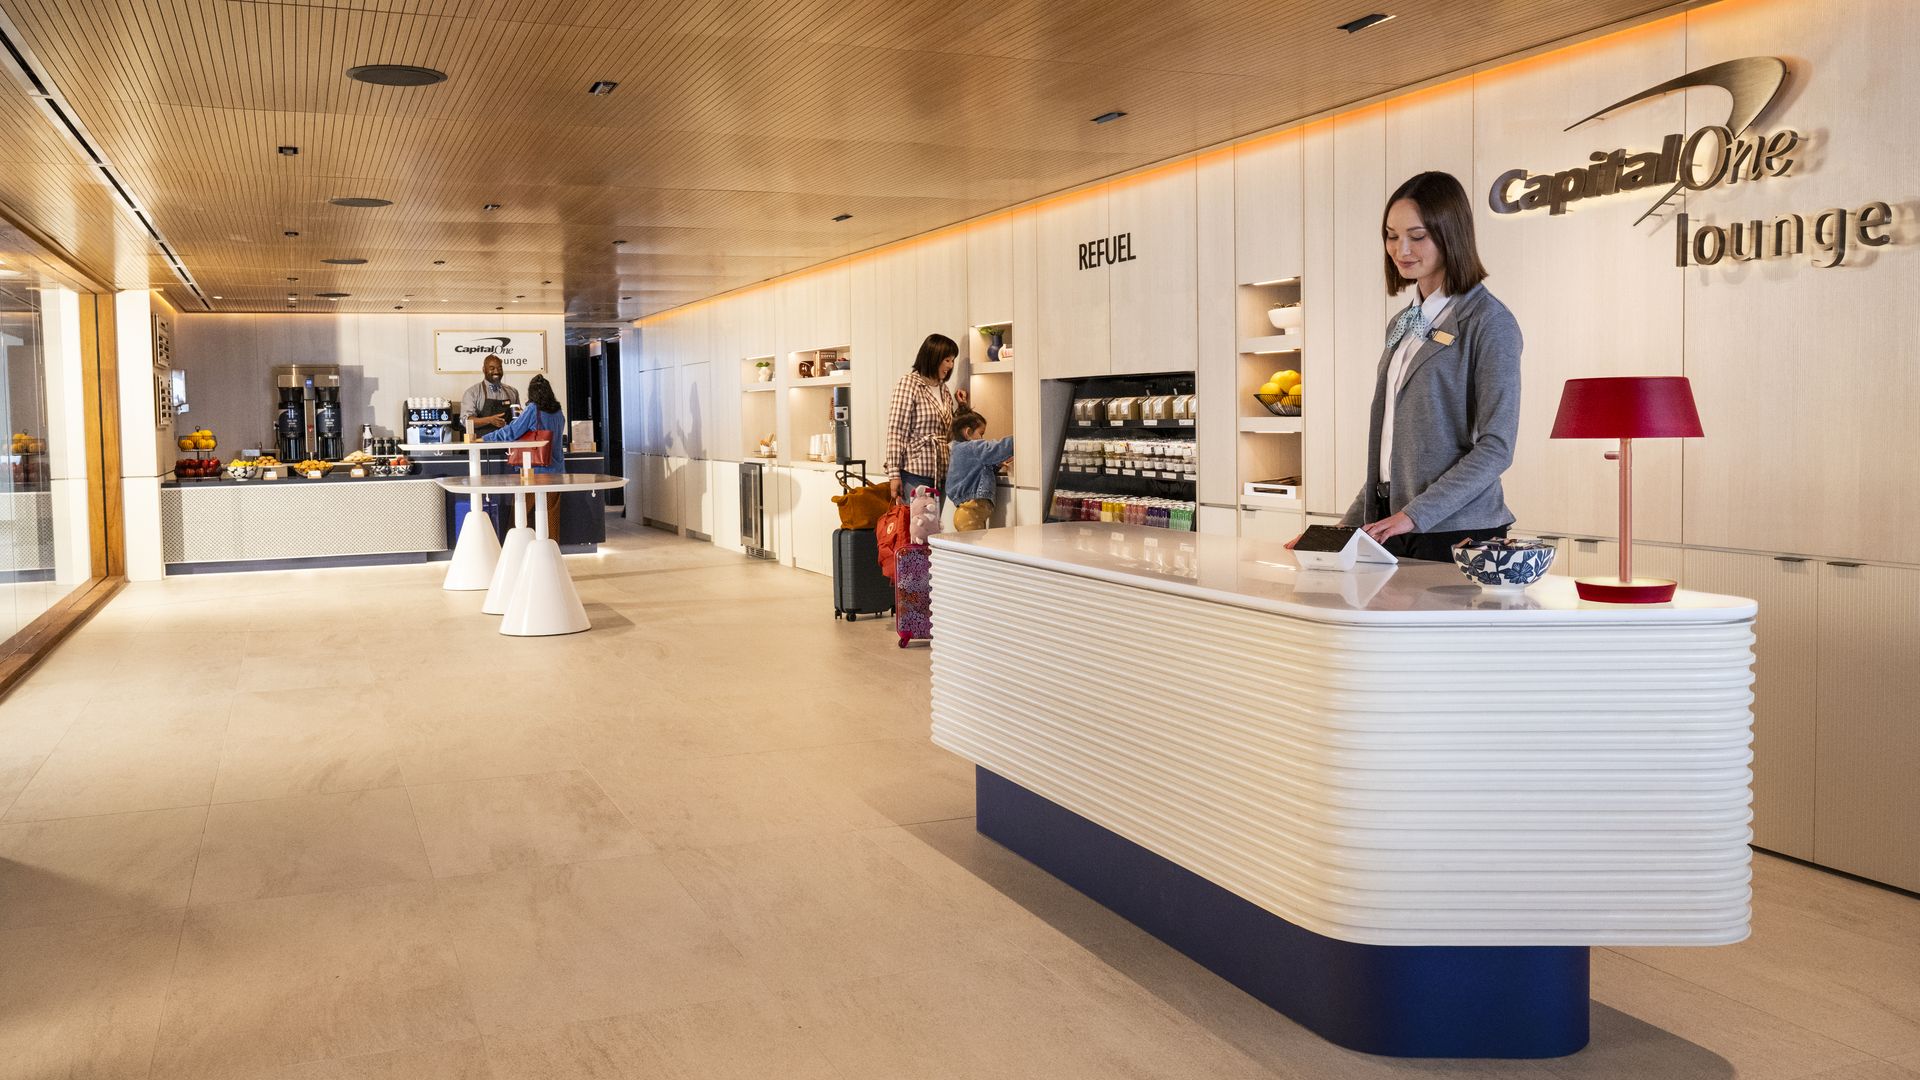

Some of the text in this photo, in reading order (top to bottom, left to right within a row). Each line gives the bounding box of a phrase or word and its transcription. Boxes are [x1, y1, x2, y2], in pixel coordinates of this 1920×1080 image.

[1488, 125, 1799, 216] Capital One
[1079, 232, 1136, 270] REFUEL
[1676, 200, 1892, 268] lounge
[454, 345, 494, 354] Capital
[503, 357, 528, 367] unge
